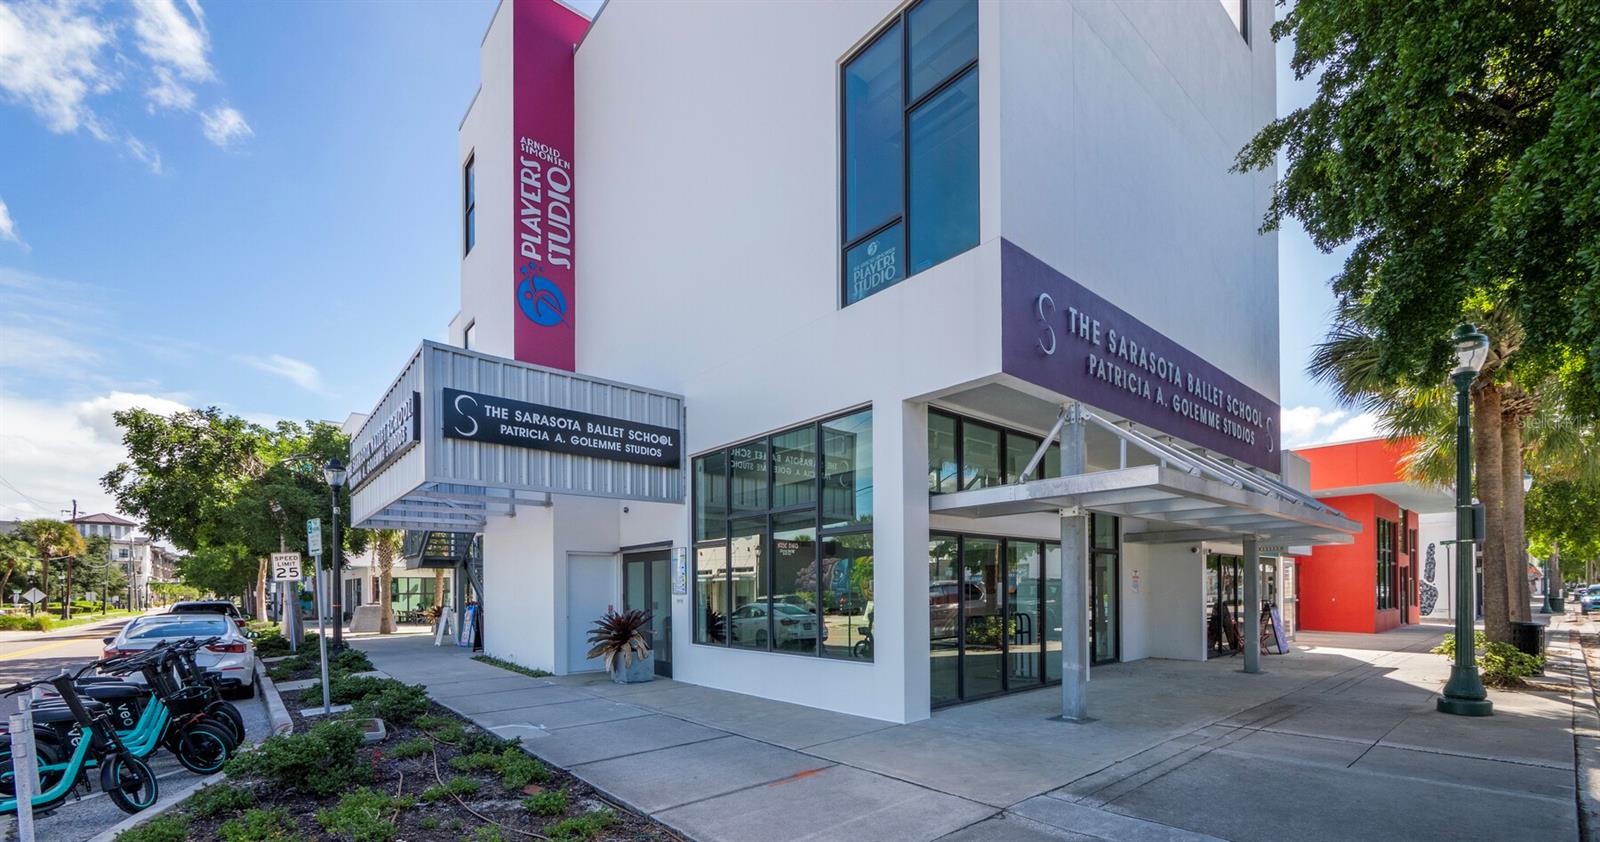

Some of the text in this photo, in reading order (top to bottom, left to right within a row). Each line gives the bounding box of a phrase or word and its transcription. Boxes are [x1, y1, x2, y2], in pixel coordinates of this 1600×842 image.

[520, 136, 560, 158] ARNOLD
[520, 143, 571, 170] SIMONSEN
[520, 156, 542, 261] PLAYERS
[546, 166, 571, 270] STUDIO
[853, 252, 896, 283] PLAYERS
[853, 265, 896, 298] STUDIO
[1068, 307, 1263, 428] THE SARASOTA BALLET SCHOOL
[1089, 354, 1255, 446] PATRICIA A. GOLEMME STUDIOS
[484, 404, 674, 447] THE SARASOTA BALLET SCHOOL
[500, 424, 662, 458] PATRICIA A. GOLEMME STUDIOS
[276, 567, 300, 579] 25
[117, 703, 134, 727] veo
[67, 728, 82, 747] ve
